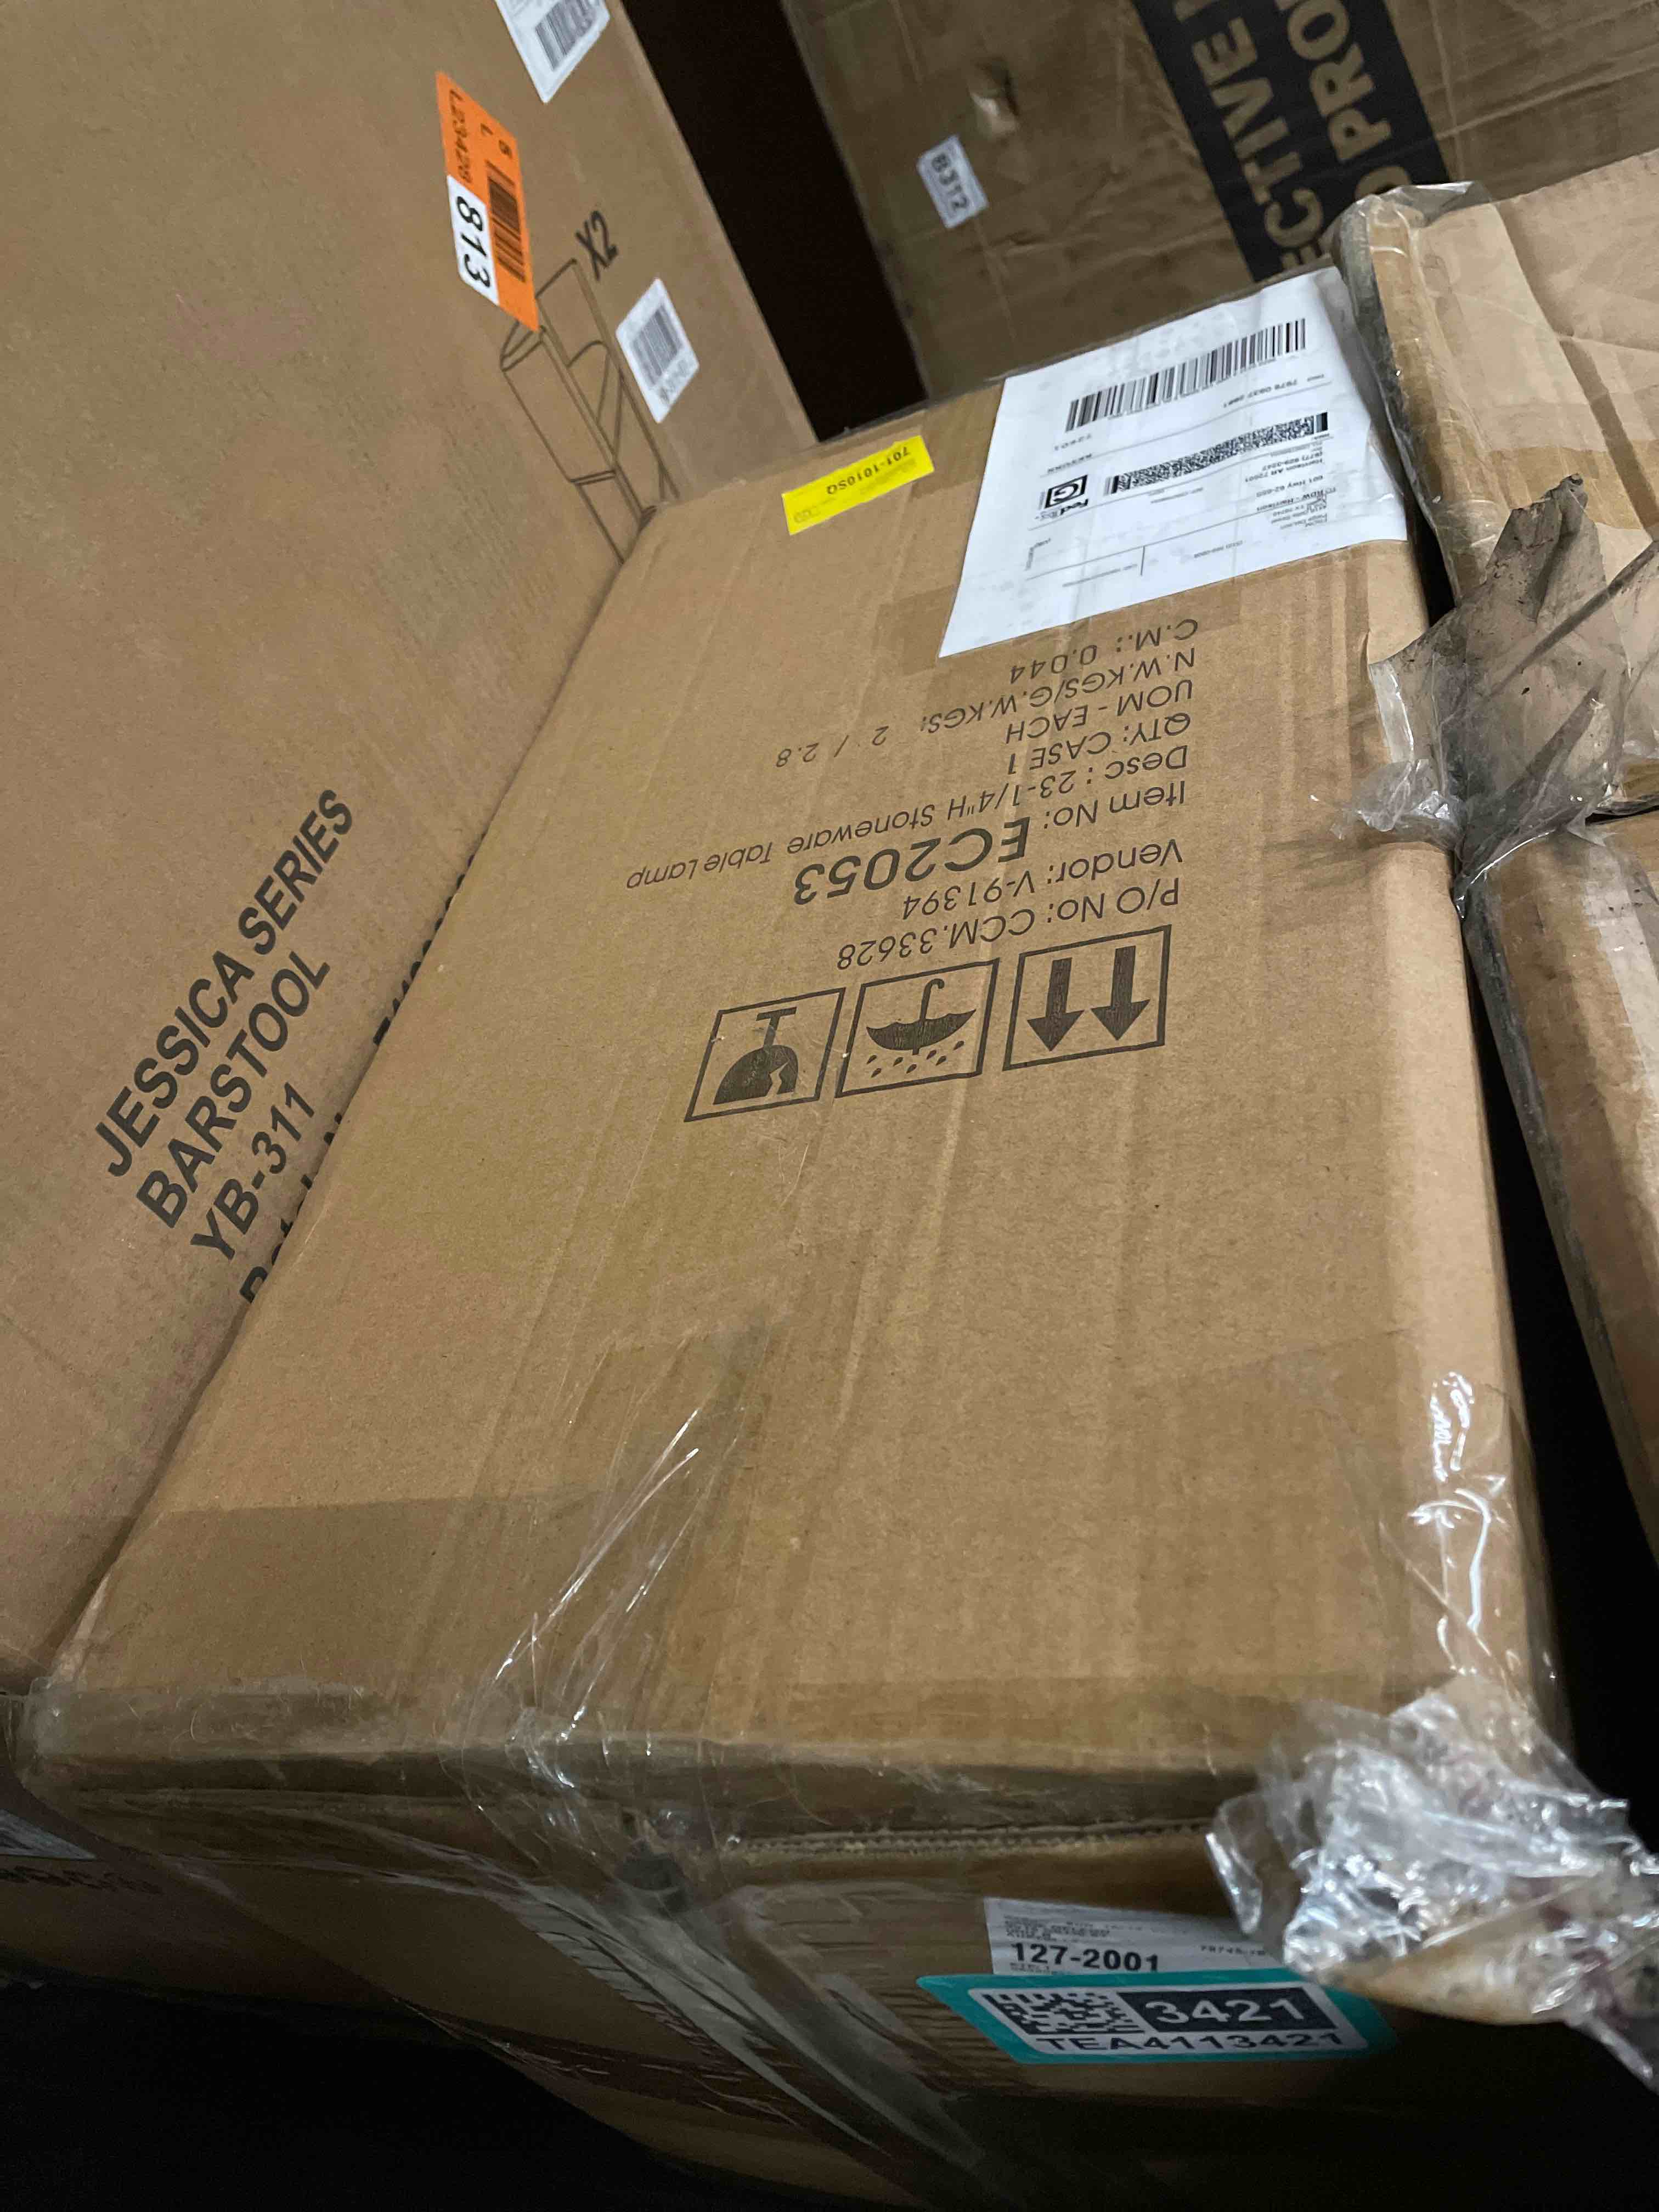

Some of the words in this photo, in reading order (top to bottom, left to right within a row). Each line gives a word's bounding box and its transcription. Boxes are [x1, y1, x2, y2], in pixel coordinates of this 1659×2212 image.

[1273, 0, 1392, 163] PRO
[456, 195, 491, 288] 813
[574, 210, 619, 281] X2
[1010, 644, 1098, 684] 0.044
[1117, 679, 1193, 717] UOM
[871, 725, 889, 746] 2
[1006, 704, 1088, 744] EACH
[1123, 712, 1191, 746] QTY:
[775, 742, 820, 768] 2.8
[833, 735, 849, 758] /
[1007, 753, 1017, 775] 1
[1029, 731, 1111, 771] CASE
[1104, 744, 1188, 780] Desc
[947, 770, 1076, 821] 23-1/4"H
[1043, 799, 1098, 830] No:
[1109, 780, 1185, 814] Item
[787, 804, 935, 854] Stoneware
[626, 859, 698, 889] Lamp
[703, 842, 773, 873] Table
[793, 816, 1030, 905] EC2053
[1047, 839, 1183, 884] Vendor:
[902, 870, 1035, 920] V-91394
[1047, 893, 1105, 923] No:
[1116, 877, 1179, 914] P/O
[837, 909, 1035, 970] CCM.33628
[95, 951, 255, 1177] JESSICA
[238, 789, 352, 955] SERIES
[136, 951, 331, 1229] BARSTOOL
[190, 1082, 315, 1260] YB-311
[1010, 1942, 1159, 1972] 127-2001
[1144, 1999, 1305, 2024] 3421
[1036, 2032, 1344, 2050] TEA4113421
